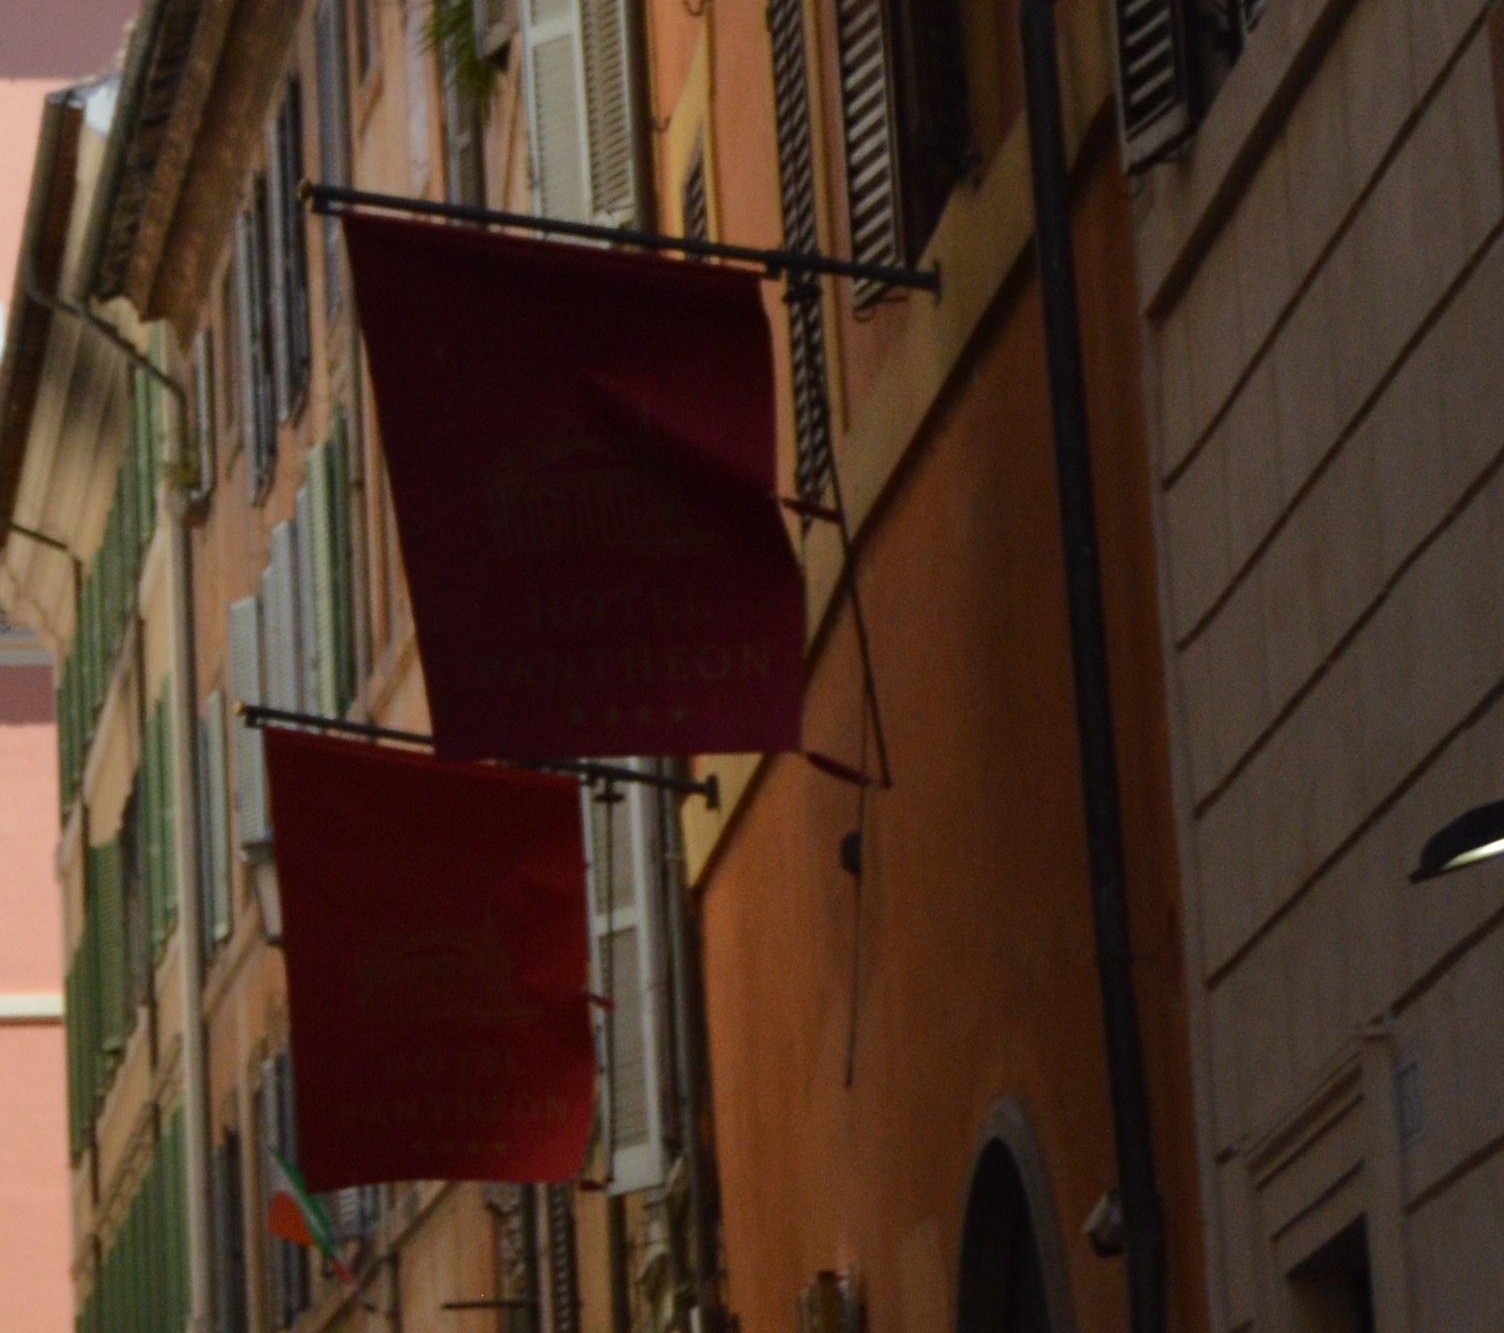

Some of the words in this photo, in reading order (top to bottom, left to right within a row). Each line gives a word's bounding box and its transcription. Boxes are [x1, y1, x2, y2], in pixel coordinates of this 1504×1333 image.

[526, 585, 708, 635] HOTEL
[472, 639, 775, 689] PANTHEON
[382, 1046, 525, 1081] HOTEL
[338, 1089, 570, 1127] PANTHEON
